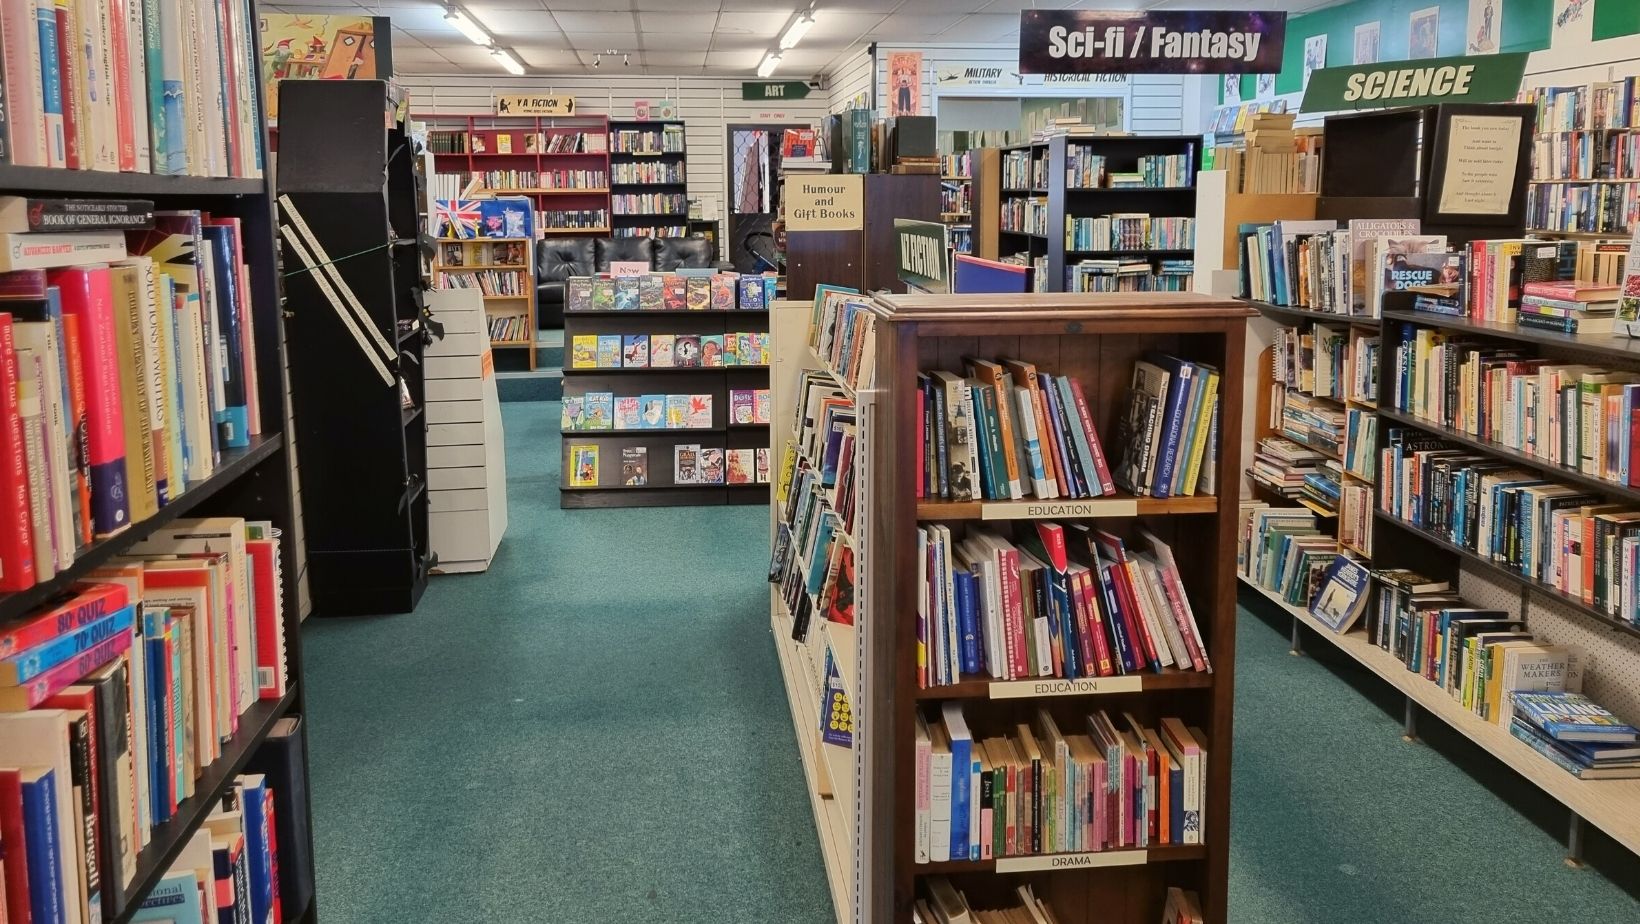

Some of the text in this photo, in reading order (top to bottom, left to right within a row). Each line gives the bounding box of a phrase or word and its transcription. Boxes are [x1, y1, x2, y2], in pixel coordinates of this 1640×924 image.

[1048, 25, 1261, 61] Sci-fi / Fantasy
[964, 68, 1002, 78] MILITARY
[1043, 73, 1127, 83] HISTORICAL FICTION
[1343, 64, 1475, 102] SCIENCE
[764, 85, 785, 97] ART
[531, 99, 558, 108] FICTION
[803, 184, 846, 194] Humour
[814, 197, 834, 206] and
[43, 214, 146, 225] BOOK OF GENERAL IGNORANCE
[794, 208, 855, 220] Gift Books
[1356, 222, 1416, 230] ALLIGATORS &
[1359, 230, 1412, 238] CROCODILES
[910, 234, 940, 281] FICTION
[1391, 270, 1432, 280] RESCUE
[146, 264, 159, 343] SOLUTIONS
[152, 358, 166, 423] WRITERS
[4, 325, 30, 545] more curious questions Max Cryer
[1140, 403, 1157, 473] TEACHING DRAMA
[1163, 409, 1181, 478] EDUCATIONAL RESEARCH
[25, 419, 41, 527] WRITERS AND EDITORS
[1028, 505, 1092, 516] EDUCATION
[77, 597, 106, 626] QUIZ
[1173, 600, 1190, 635] Economics
[91, 616, 116, 643] QUIZ
[1521, 662, 1565, 670] WEATHER
[1523, 670, 1561, 678] MAKERS
[1035, 682, 1098, 694] EDUCATION
[1529, 702, 1613, 716] LIVING
[86, 812, 100, 888] Bengali
[1051, 856, 1091, 867] DRAMA
